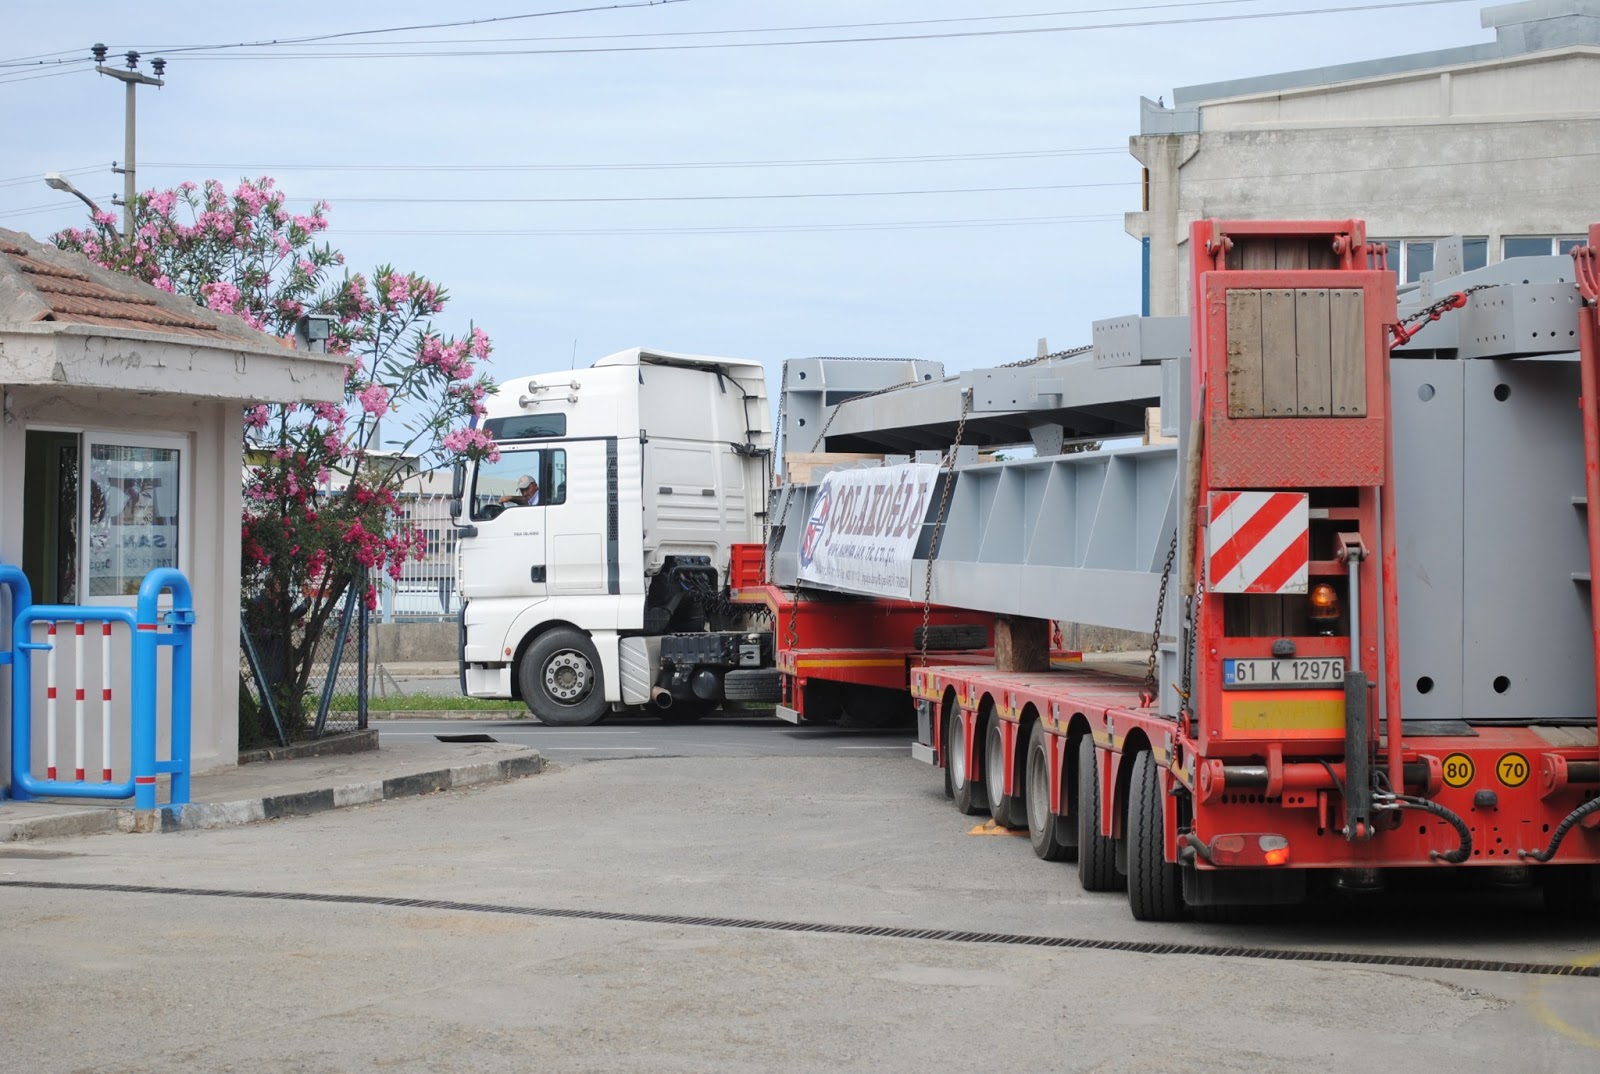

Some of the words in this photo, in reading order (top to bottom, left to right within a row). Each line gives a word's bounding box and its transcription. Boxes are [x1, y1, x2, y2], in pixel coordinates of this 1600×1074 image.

[824, 469, 928, 547] ÇOLAKOĞLU
[1237, 661, 1255, 681] 61
[1271, 661, 1281, 681] K
[1292, 661, 1342, 681] 12976
[1447, 762, 1468, 779] 80
[1503, 763, 1524, 778] 70
